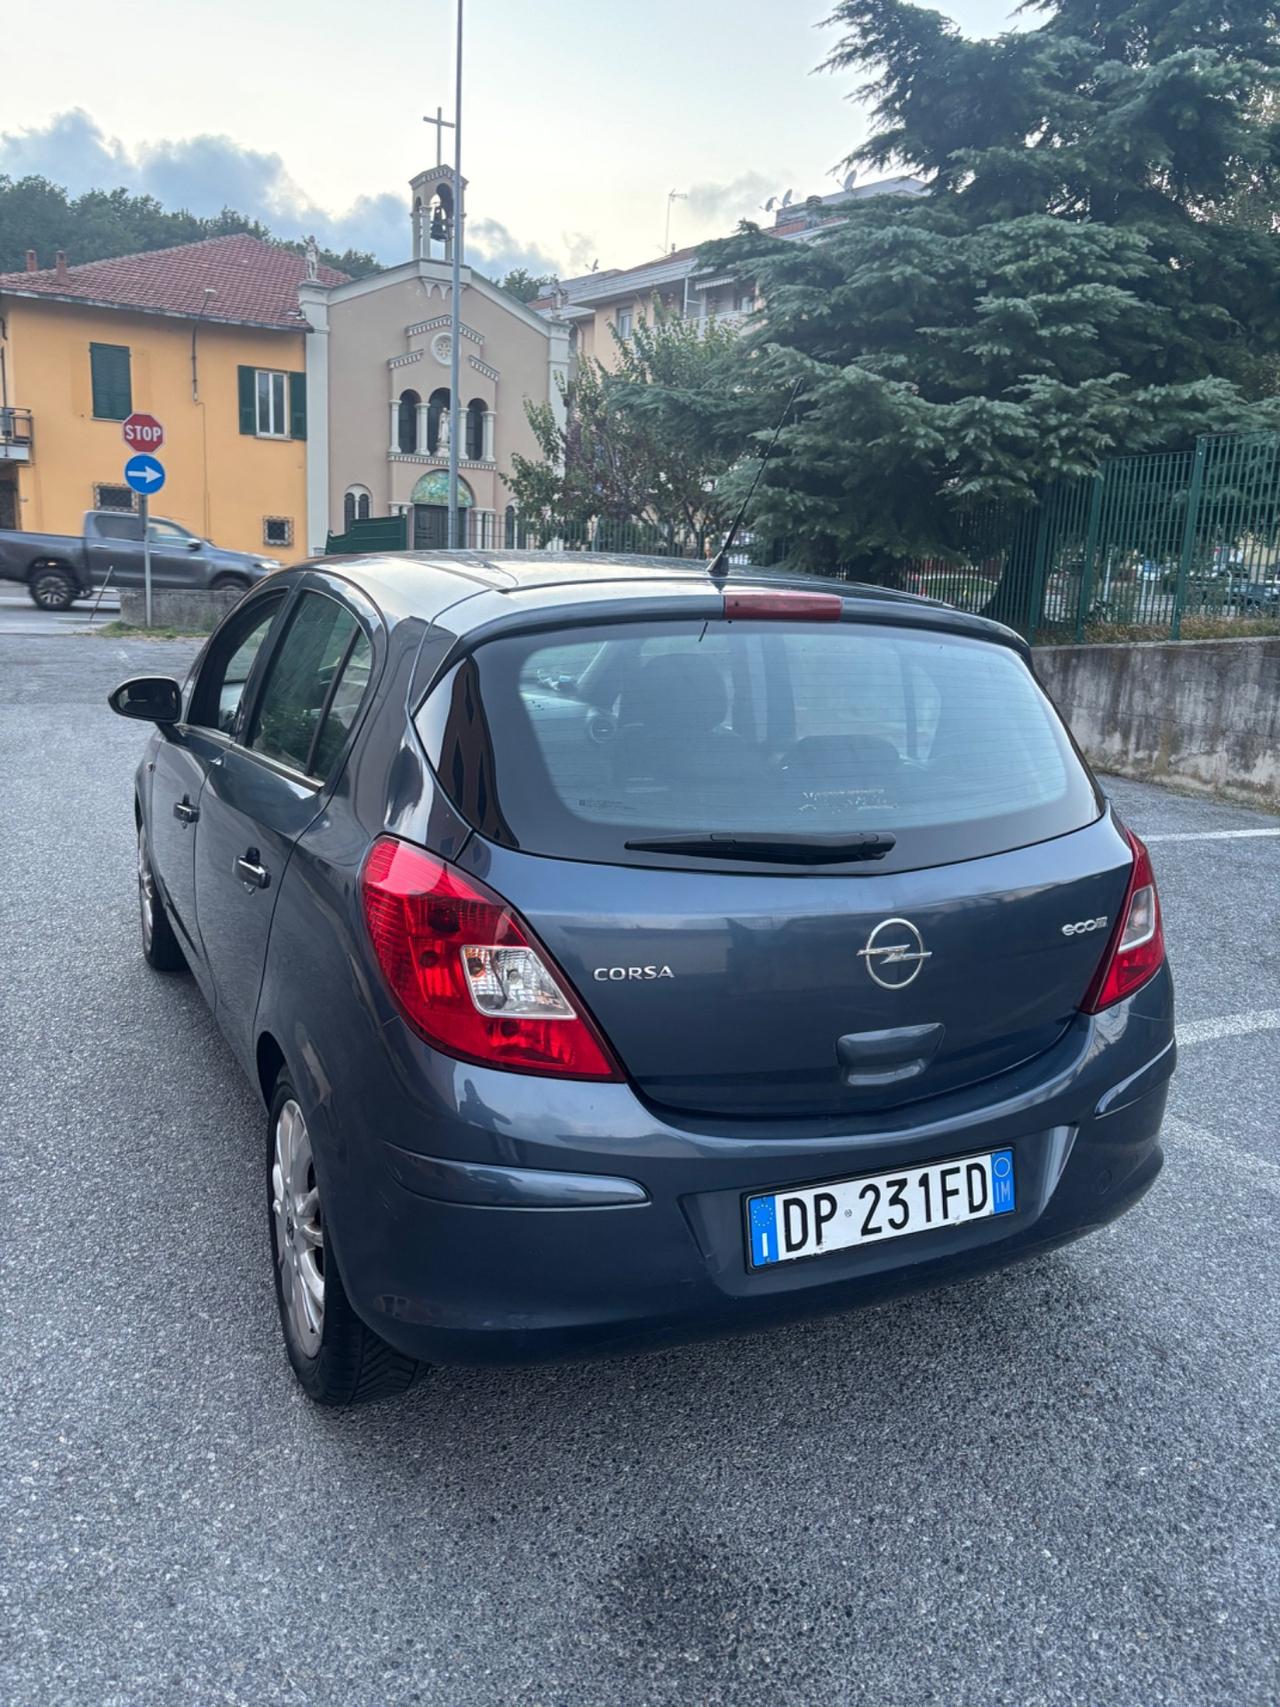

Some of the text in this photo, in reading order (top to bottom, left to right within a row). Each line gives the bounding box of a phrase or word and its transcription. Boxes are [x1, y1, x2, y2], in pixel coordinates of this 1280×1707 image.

[125, 424, 162, 442] STOP
[593, 965, 675, 981] CORSA
[782, 1162, 988, 1253] DP 231FD
[761, 1232, 769, 1257] I
